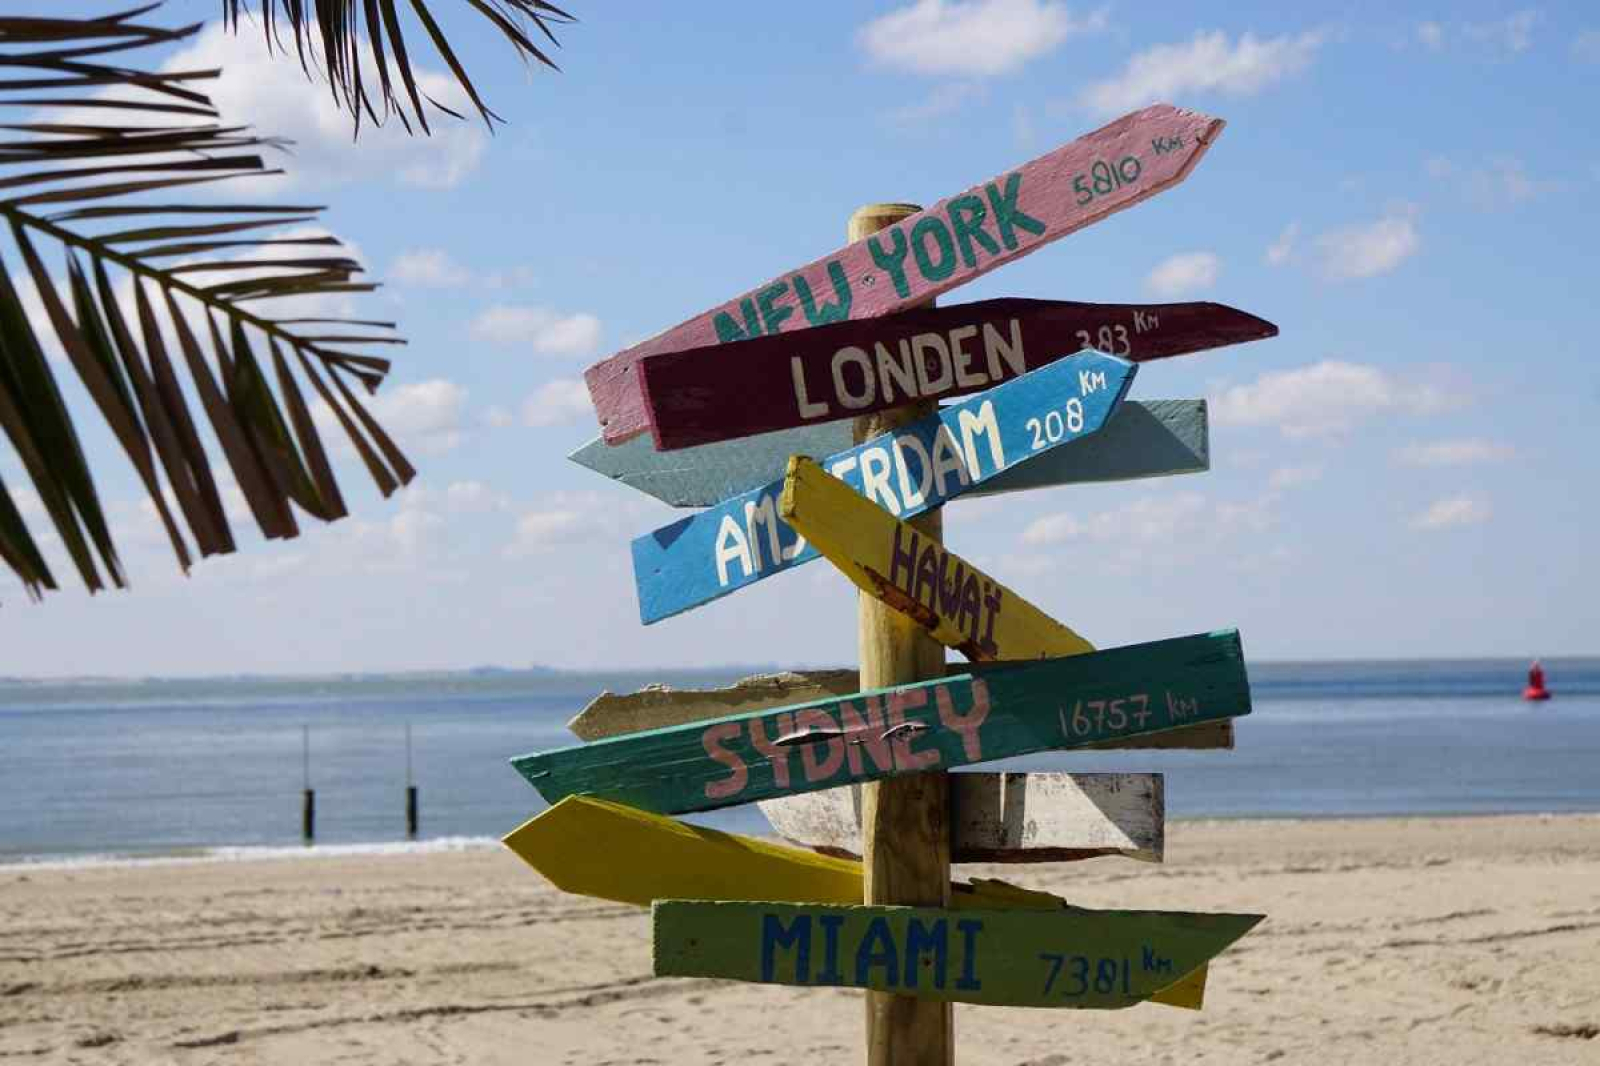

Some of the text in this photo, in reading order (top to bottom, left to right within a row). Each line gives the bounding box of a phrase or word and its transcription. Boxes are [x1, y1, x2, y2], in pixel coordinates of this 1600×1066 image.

[714, 260, 852, 342] NEW
[867, 171, 1046, 298] YORK
[1072, 155, 1142, 206] 5810
[791, 318, 1026, 419] LONDEN
[1026, 397, 1085, 450] 208
[702, 678, 991, 799] SYDNEY
[1058, 693, 1152, 738] 16757
[761, 913, 983, 991] MIAMI
[1037, 953, 1132, 997] 7381
